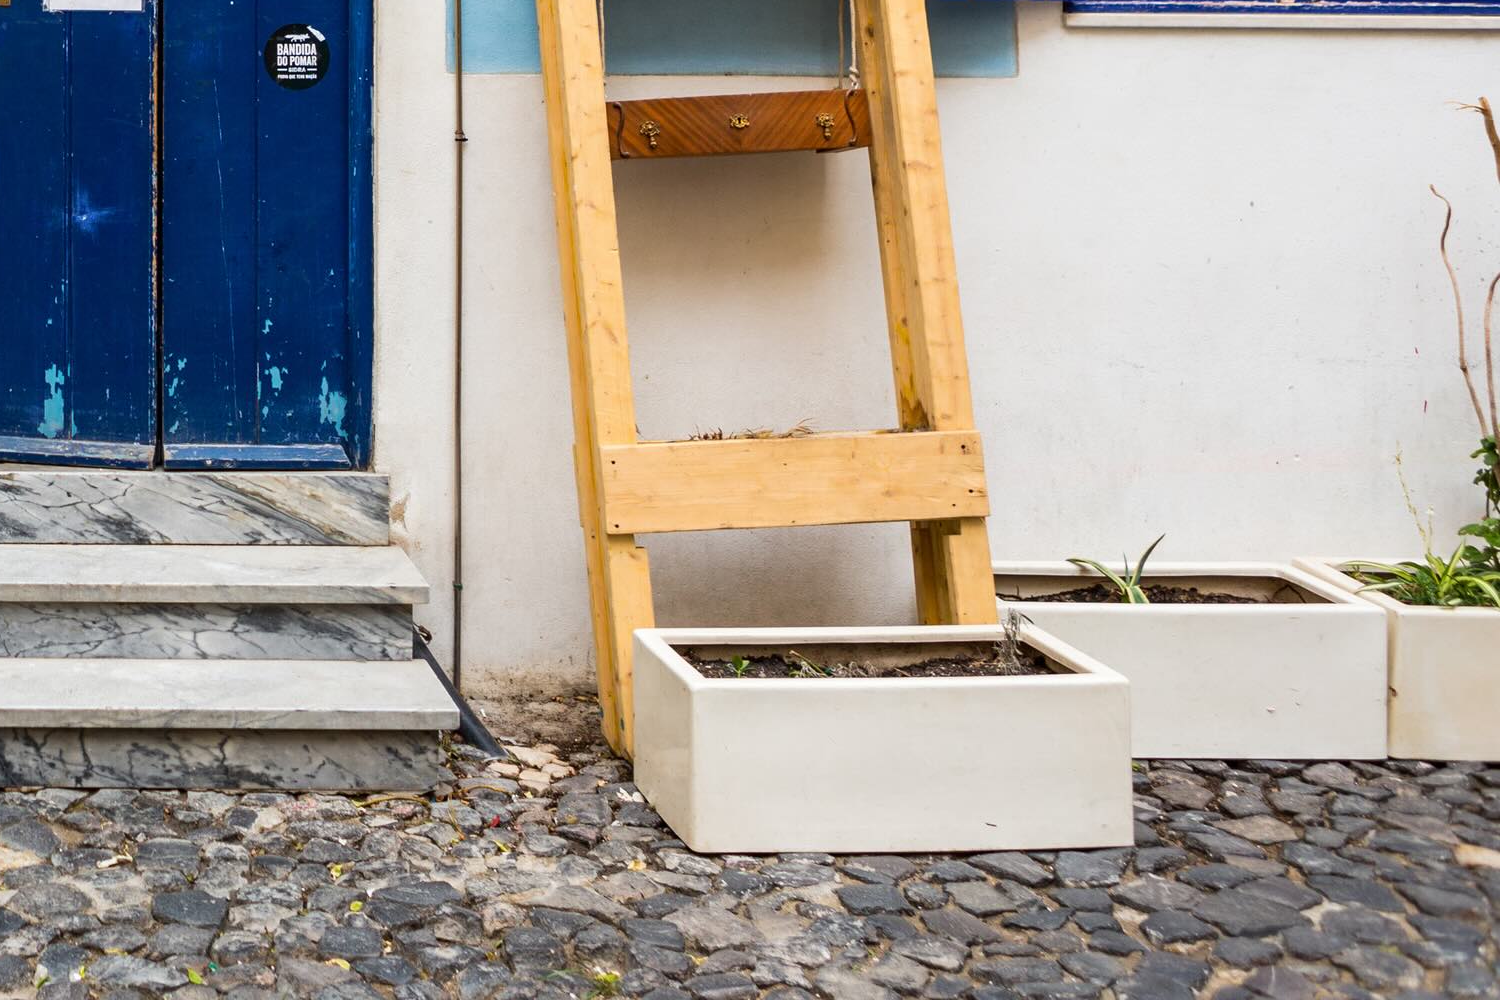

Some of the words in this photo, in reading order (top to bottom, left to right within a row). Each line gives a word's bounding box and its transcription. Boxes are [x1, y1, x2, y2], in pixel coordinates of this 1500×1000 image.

[277, 43, 317, 56] BANDIDA
[277, 56, 288, 67] DO
[290, 56, 317, 67] POMAR
